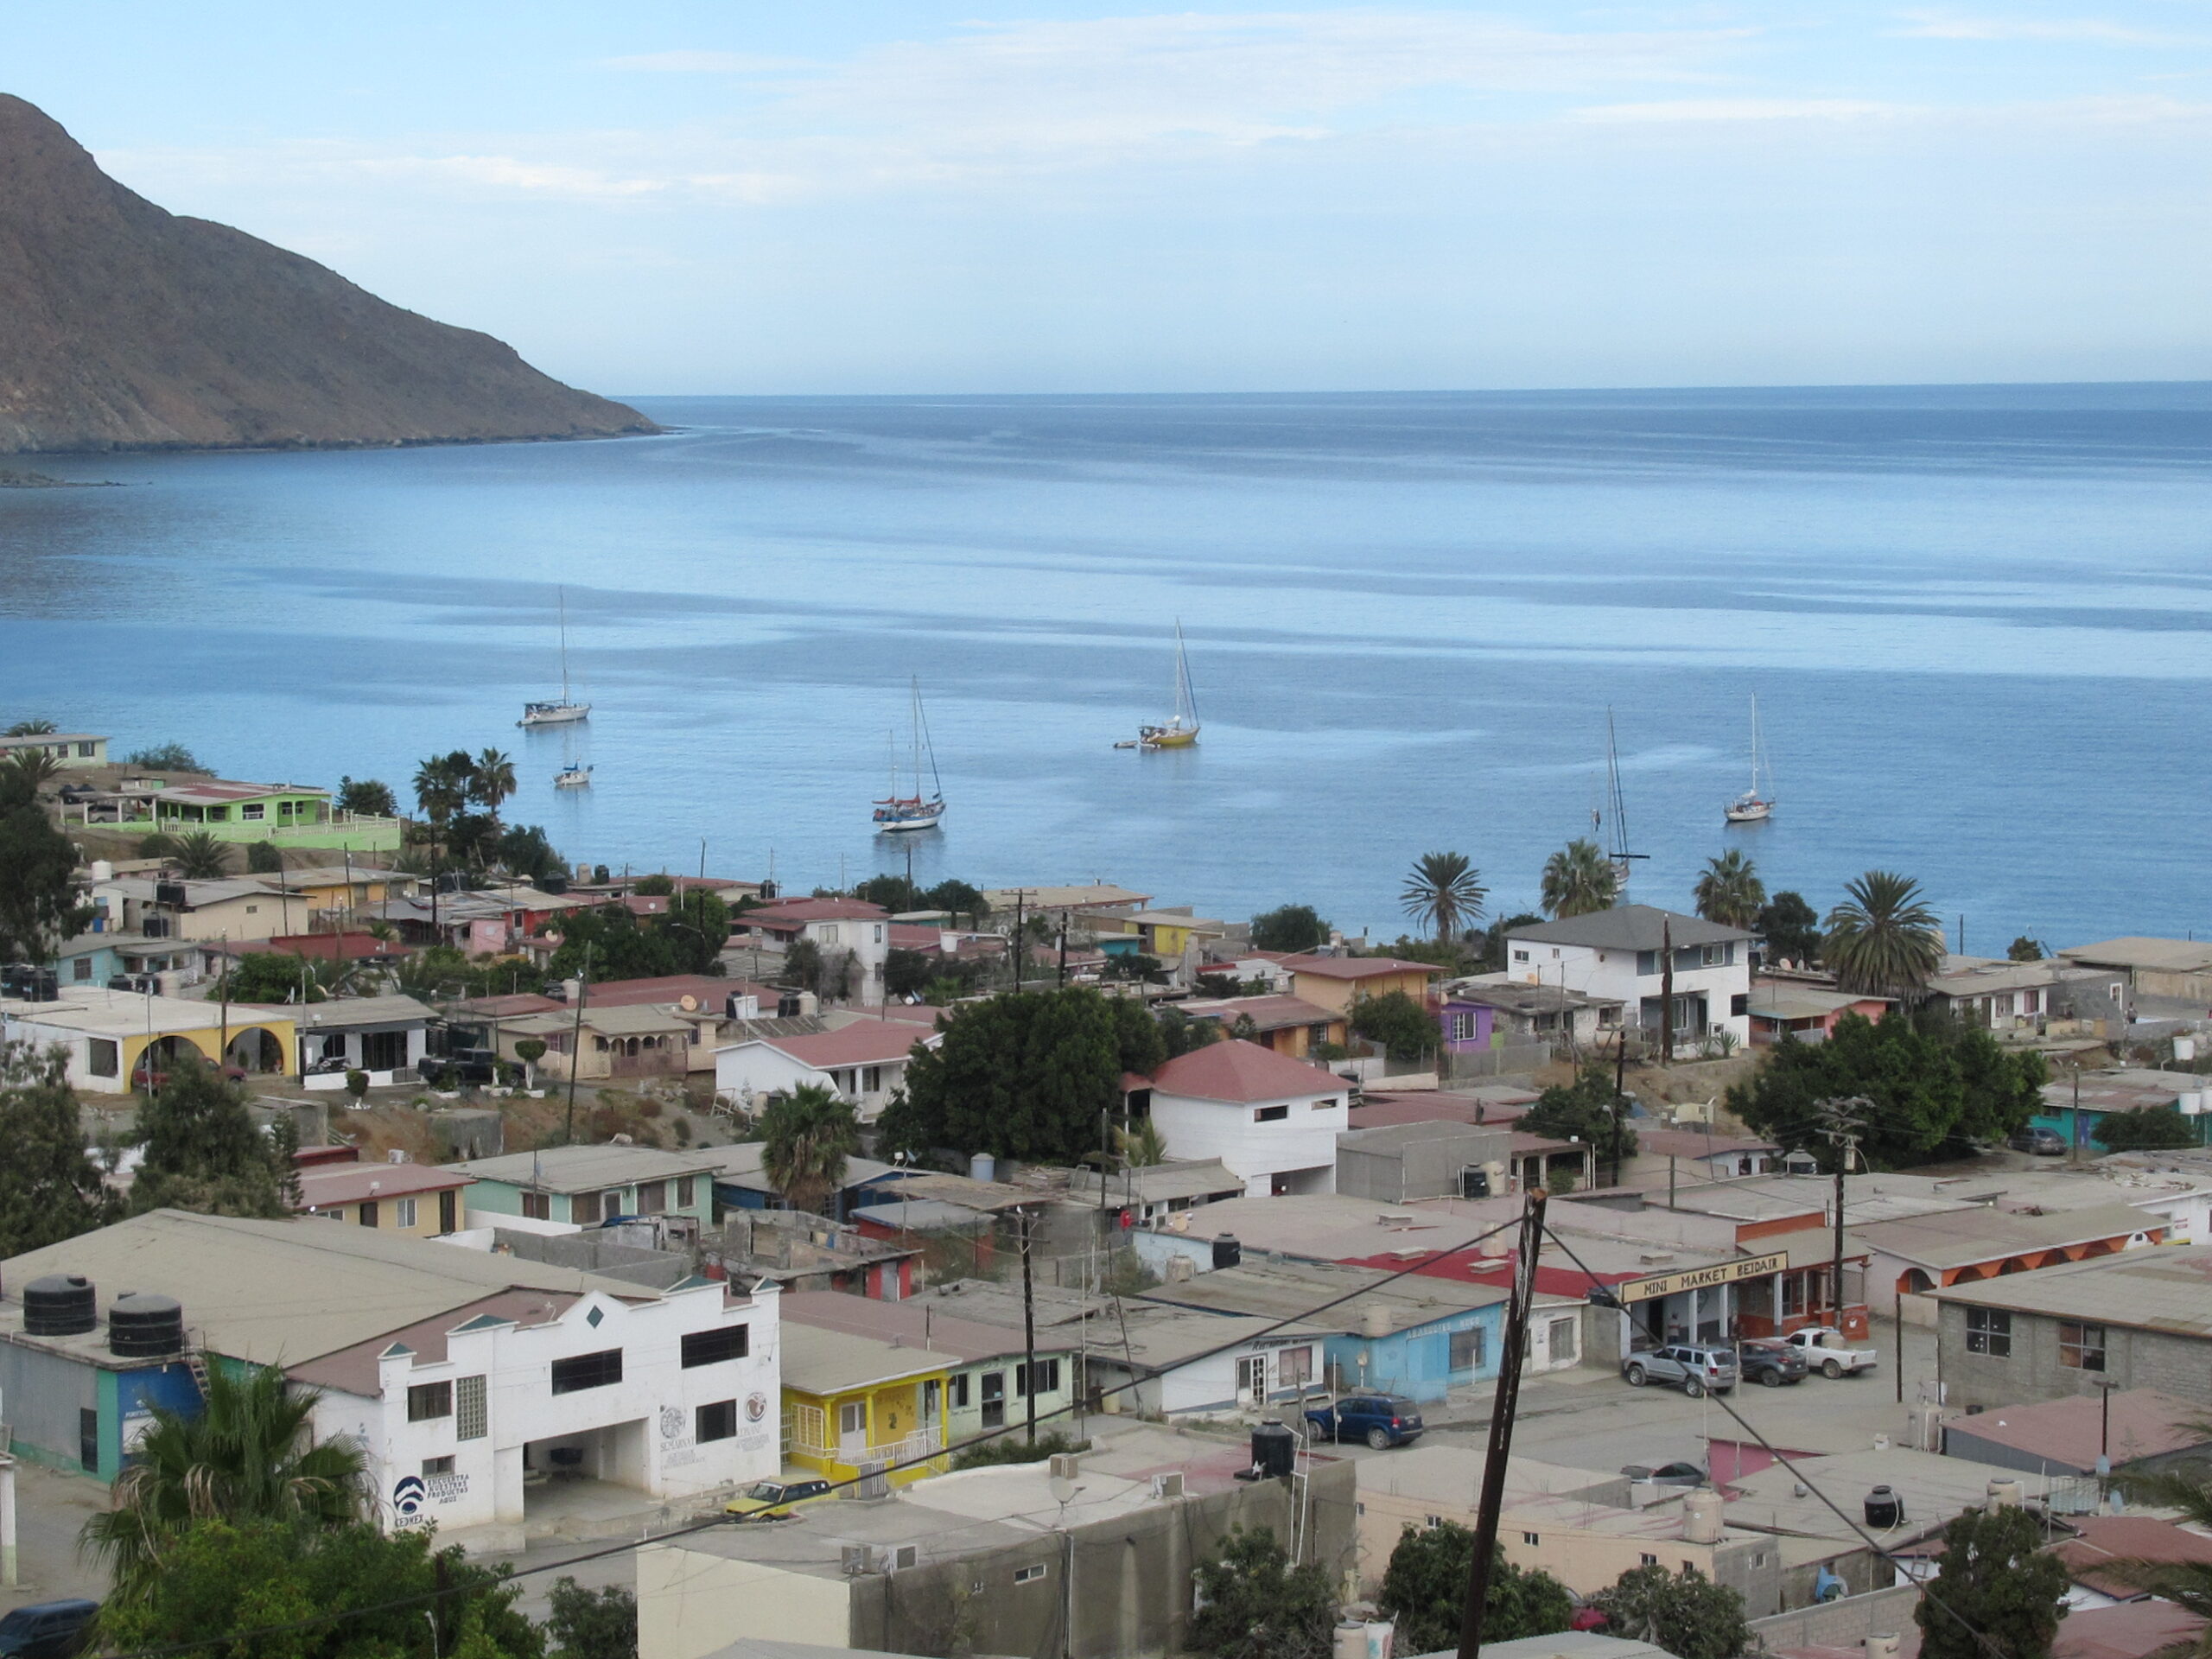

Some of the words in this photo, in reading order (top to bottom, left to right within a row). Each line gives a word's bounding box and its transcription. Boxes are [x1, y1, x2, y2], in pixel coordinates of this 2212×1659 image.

[1644, 1280, 1668, 1295] MINI
[1681, 1268, 1727, 1288] MARKET
[427, 1488, 468, 1499] PRODUCTOS
